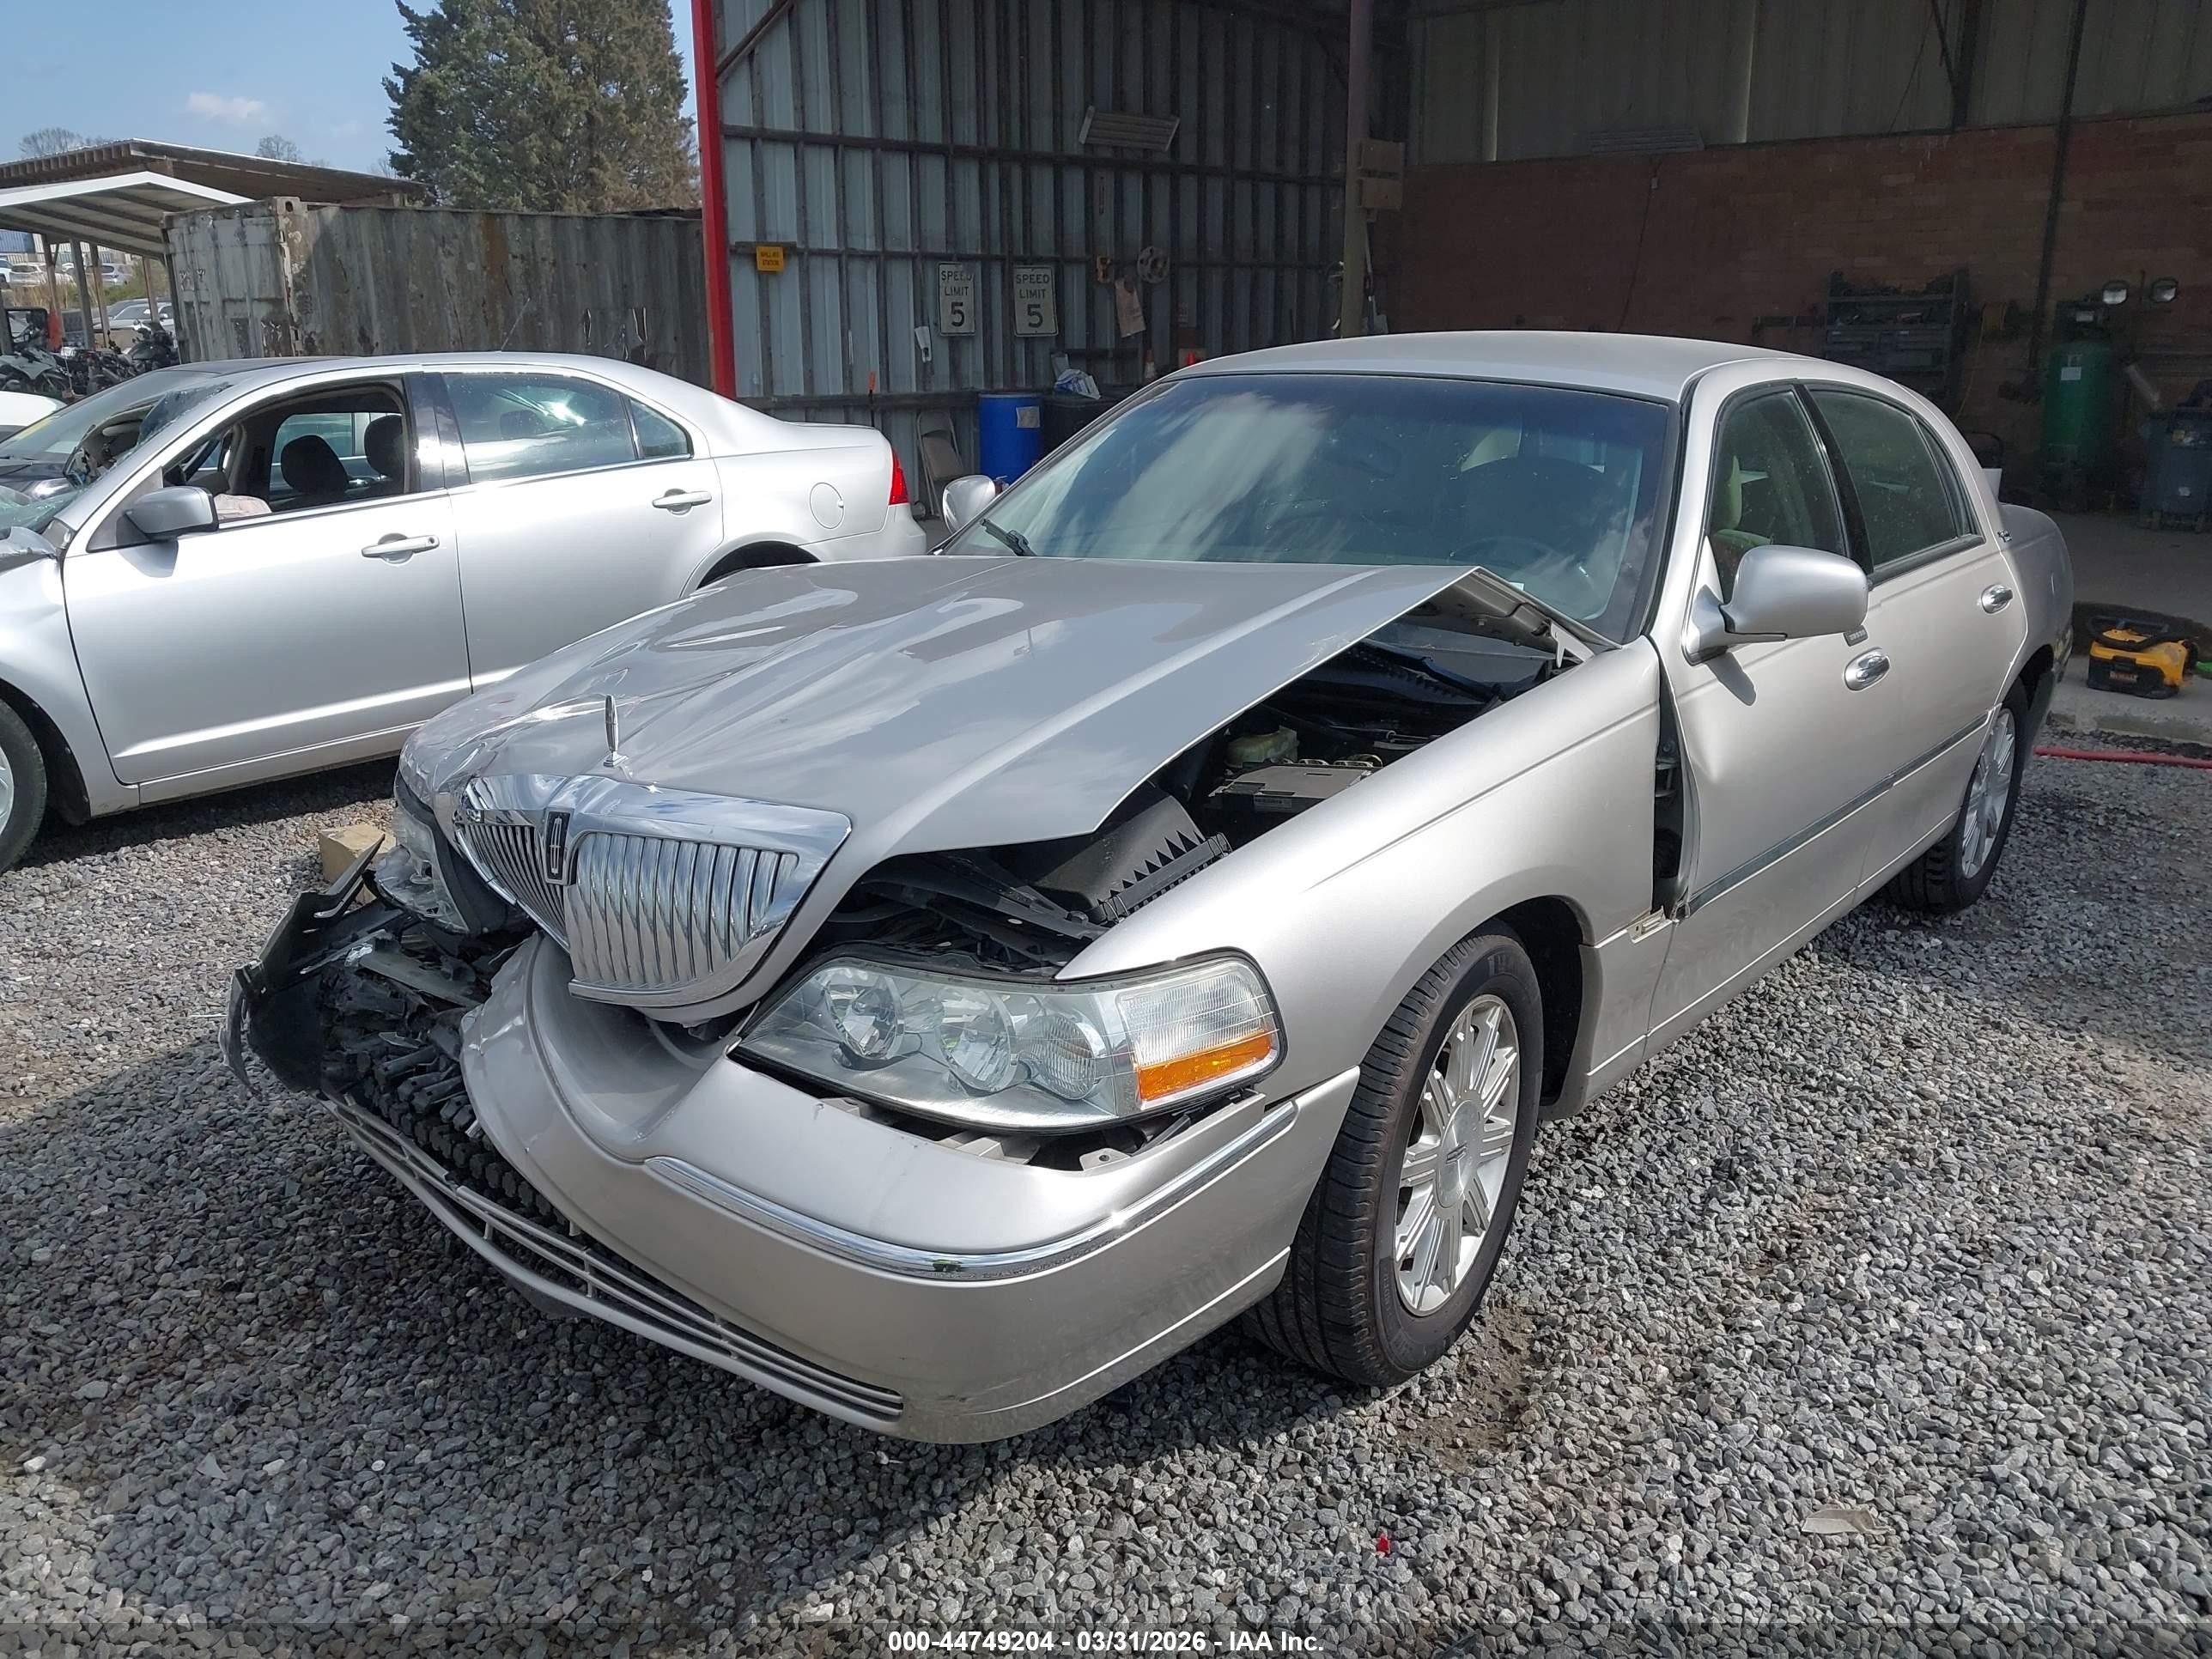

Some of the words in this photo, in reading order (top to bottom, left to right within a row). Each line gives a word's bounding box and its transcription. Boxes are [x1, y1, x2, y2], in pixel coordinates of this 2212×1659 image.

[940, 270, 975, 283] SPEED
[1015, 273, 1049, 284] SPEED
[944, 286, 969, 296] LIMIT
[1019, 289, 1047, 299] LIMIT
[951, 301, 965, 327] 5
[1027, 303, 1043, 328] 5
